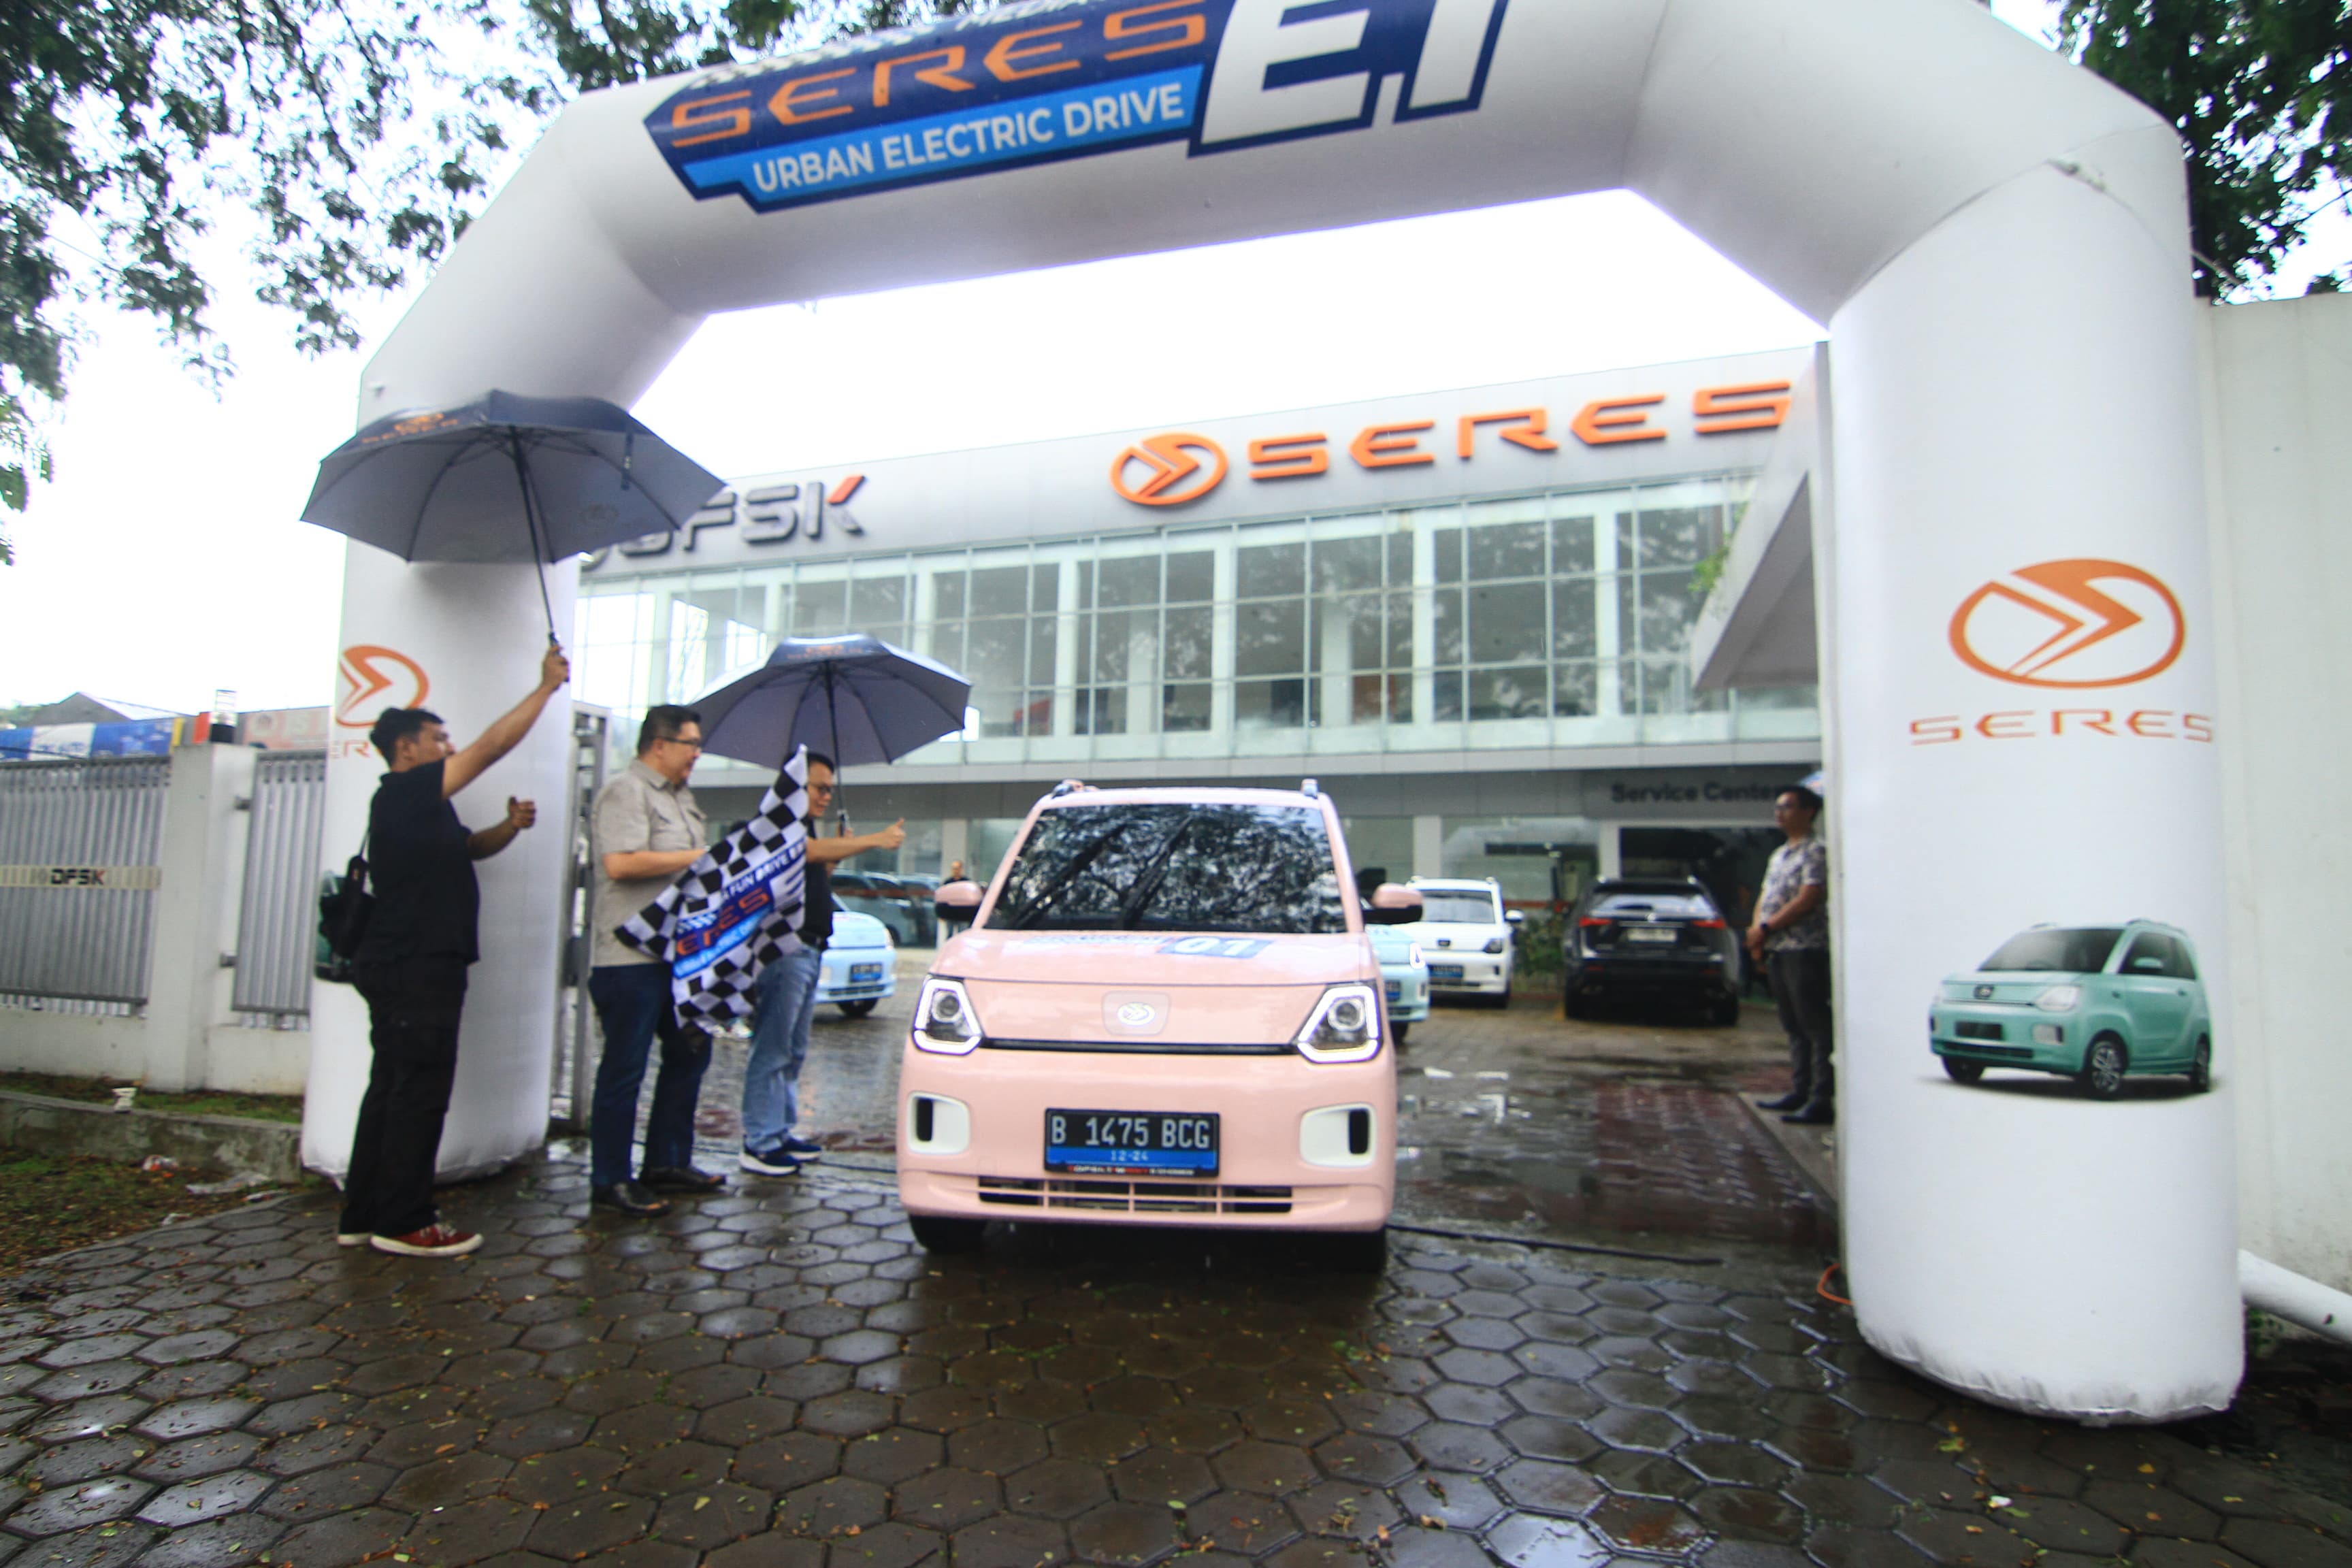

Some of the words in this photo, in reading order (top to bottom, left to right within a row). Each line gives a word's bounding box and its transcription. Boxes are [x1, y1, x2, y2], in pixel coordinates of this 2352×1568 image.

[671, 0, 1206, 148] SERES
[753, 143, 875, 194] URBAN
[884, 108, 1053, 170] ELECTRIC
[1064, 83, 1185, 137] DRIVE
[1247, 380, 1791, 480] SERES
[1909, 708, 2214, 745] SERES
[1611, 783, 1699, 803] Service
[51, 868, 105, 885] DFSK
[1174, 937, 1257, 956] 01
[1051, 1115, 1067, 1145] B
[1085, 1116, 1149, 1147] 1475
[1161, 1118, 1210, 1149] BCG
[1111, 1149, 1149, 1162] 12-24
